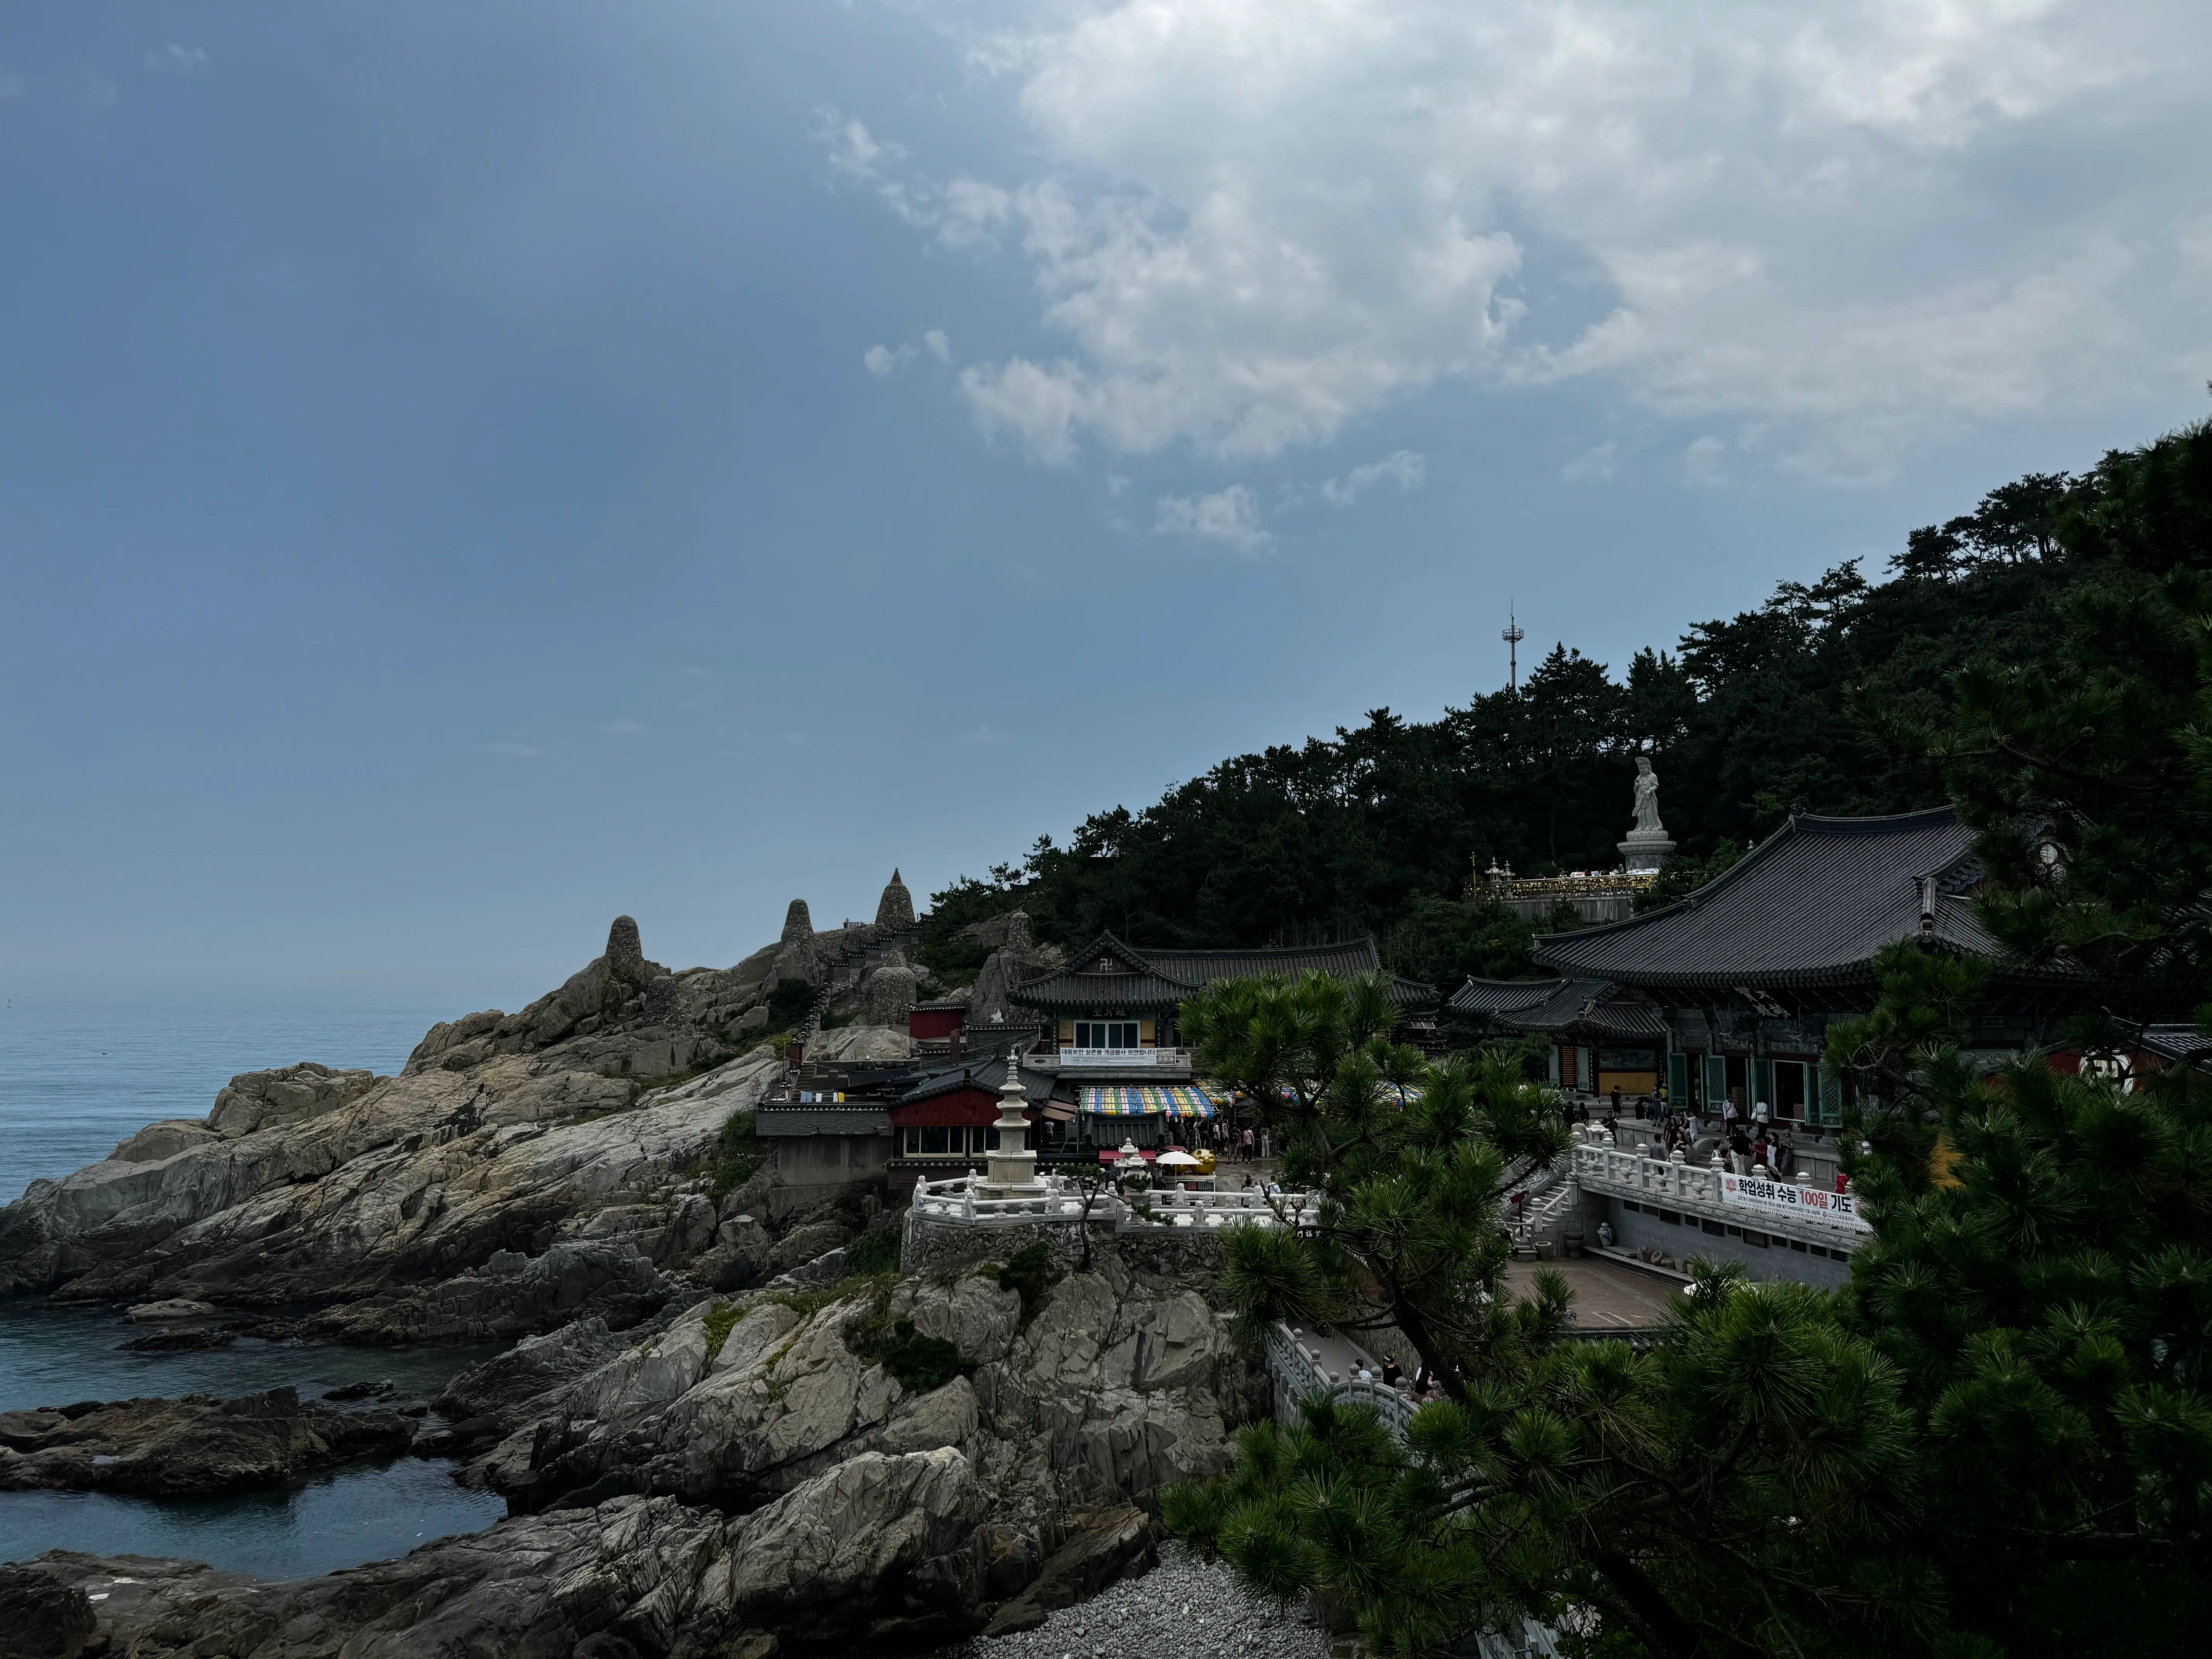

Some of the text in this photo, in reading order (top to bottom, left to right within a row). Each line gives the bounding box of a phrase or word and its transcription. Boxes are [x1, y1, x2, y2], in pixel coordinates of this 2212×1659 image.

[1738, 1178, 1852, 1213] 학업성취 수능 100일 기도
